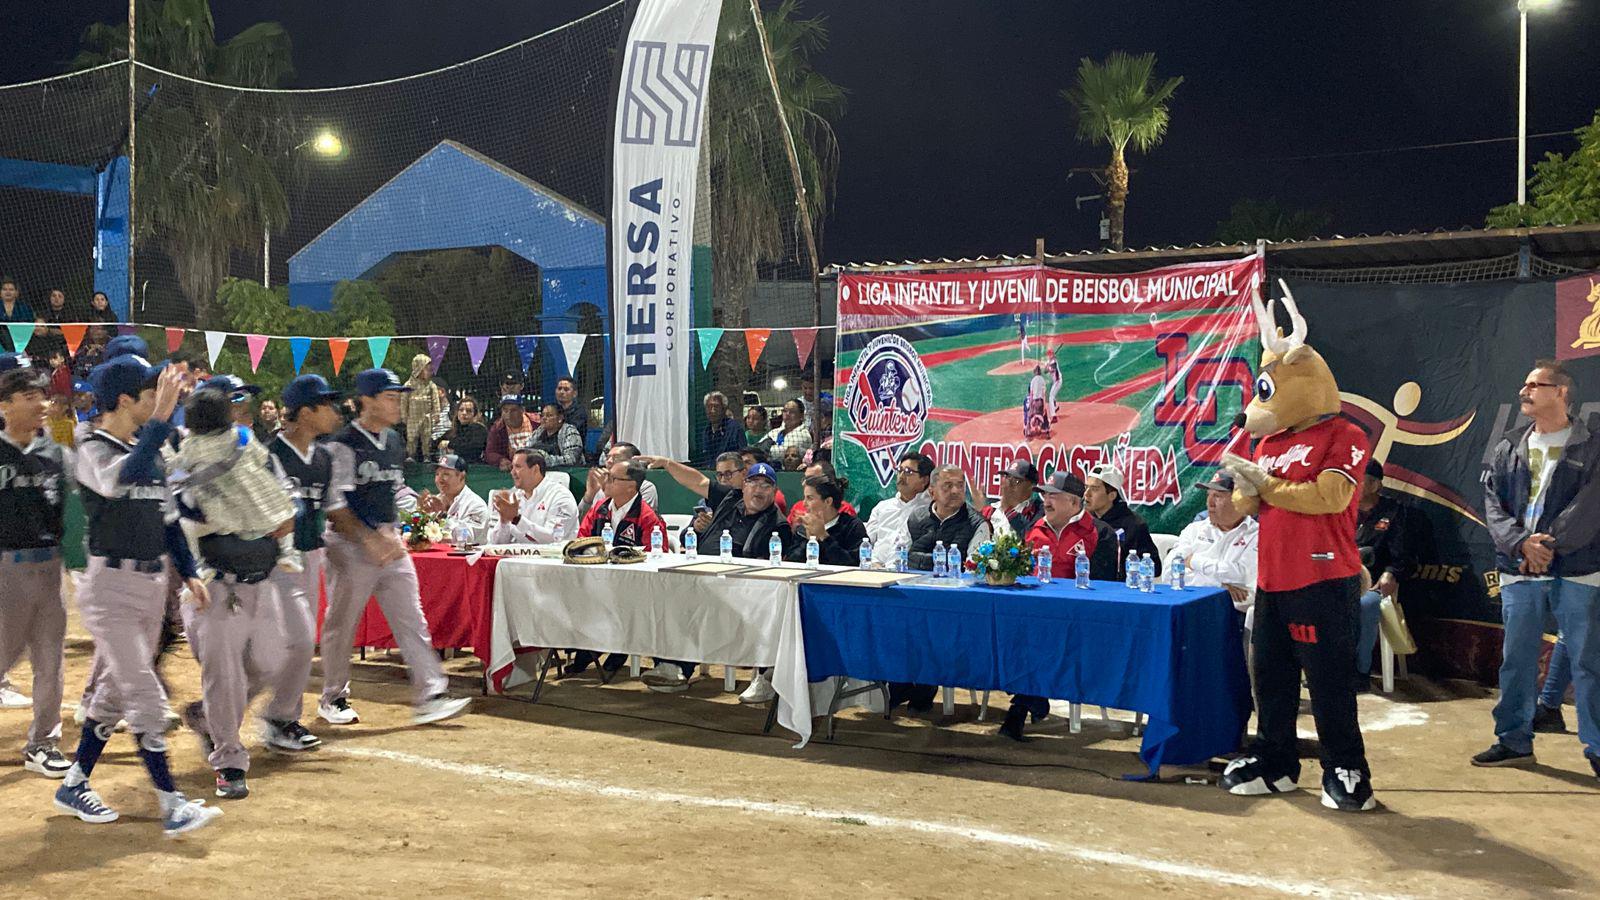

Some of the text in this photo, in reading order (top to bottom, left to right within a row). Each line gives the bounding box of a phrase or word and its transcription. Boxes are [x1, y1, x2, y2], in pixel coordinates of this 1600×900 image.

[626, 177, 663, 378] HERSA
[666, 198, 681, 351] CORPORATIVO
[858, 271, 1239, 310] LIGA INFANTIL Y JUVENIL DE BEISBOL MUNICIPAL
[858, 397, 918, 434] Quintero
